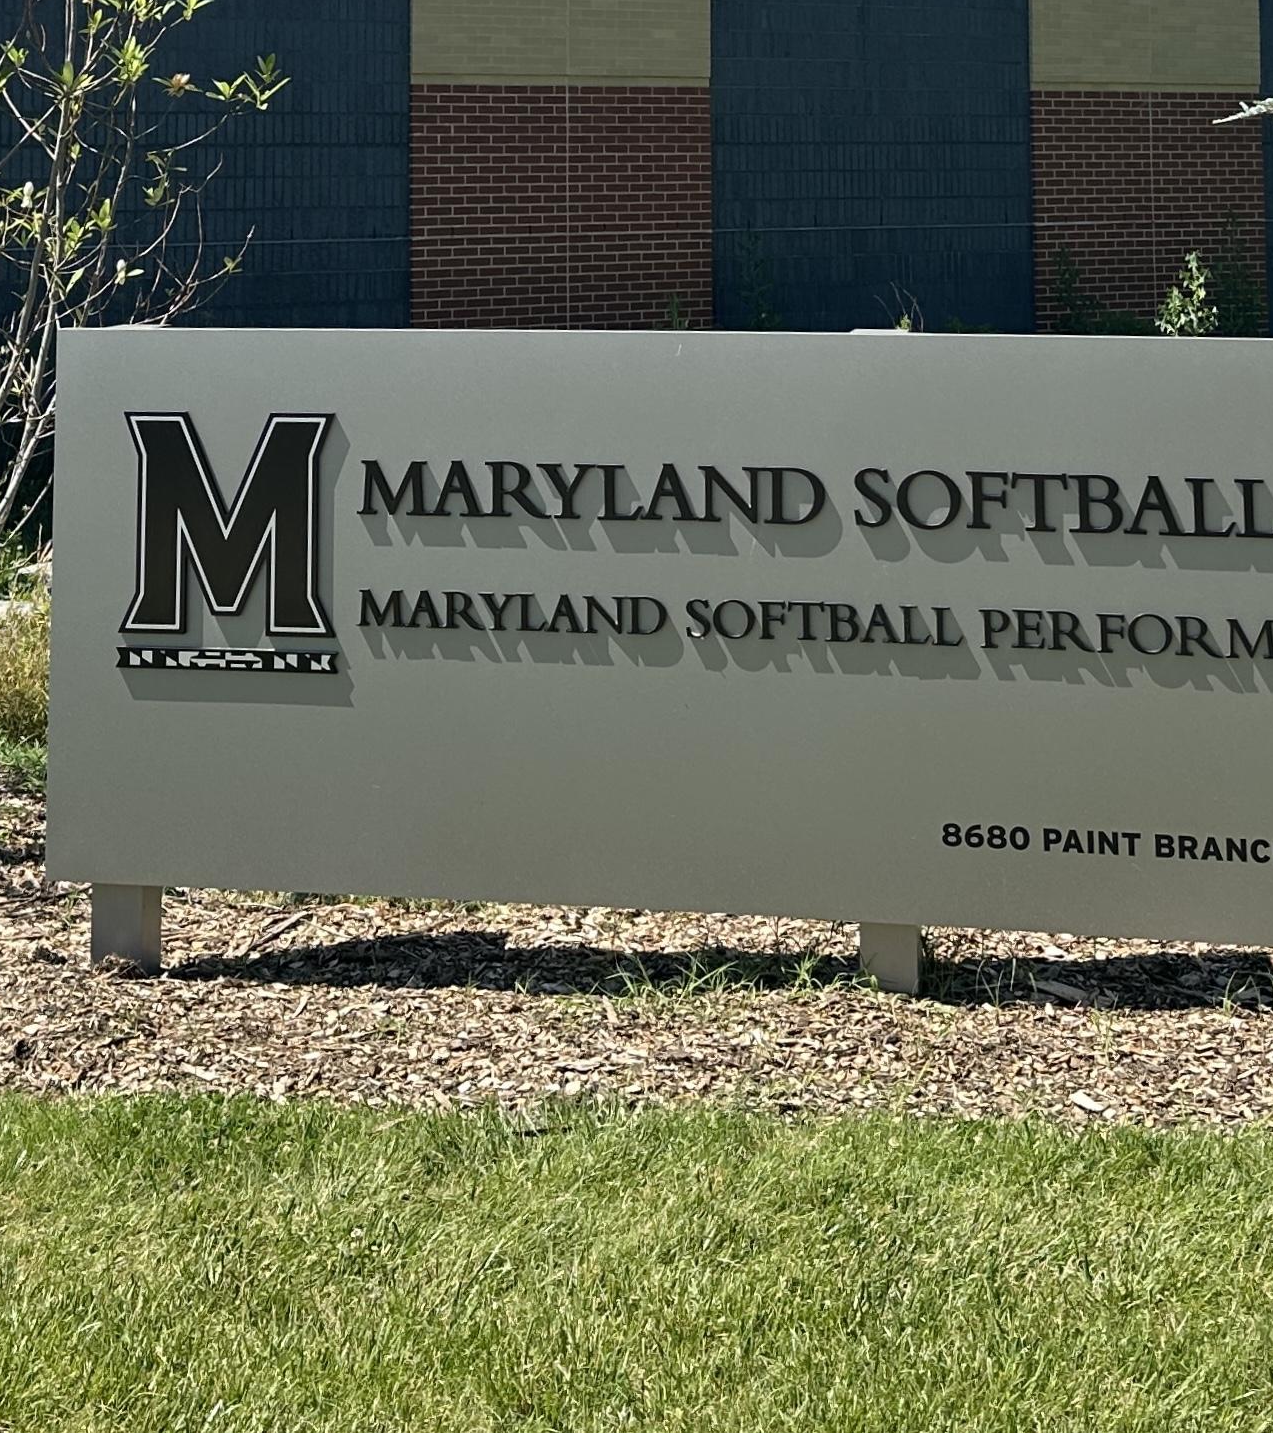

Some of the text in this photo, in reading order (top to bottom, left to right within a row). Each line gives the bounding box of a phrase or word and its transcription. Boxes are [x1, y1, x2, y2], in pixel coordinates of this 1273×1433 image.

[356, 459, 827, 527] MARYLAND
[117, 411, 337, 639] M
[357, 588, 669, 637] MARYLAND
[685, 598, 964, 647] SOFTBALL
[941, 822, 1031, 852] 8680
[1042, 827, 1142, 857] PAINT
